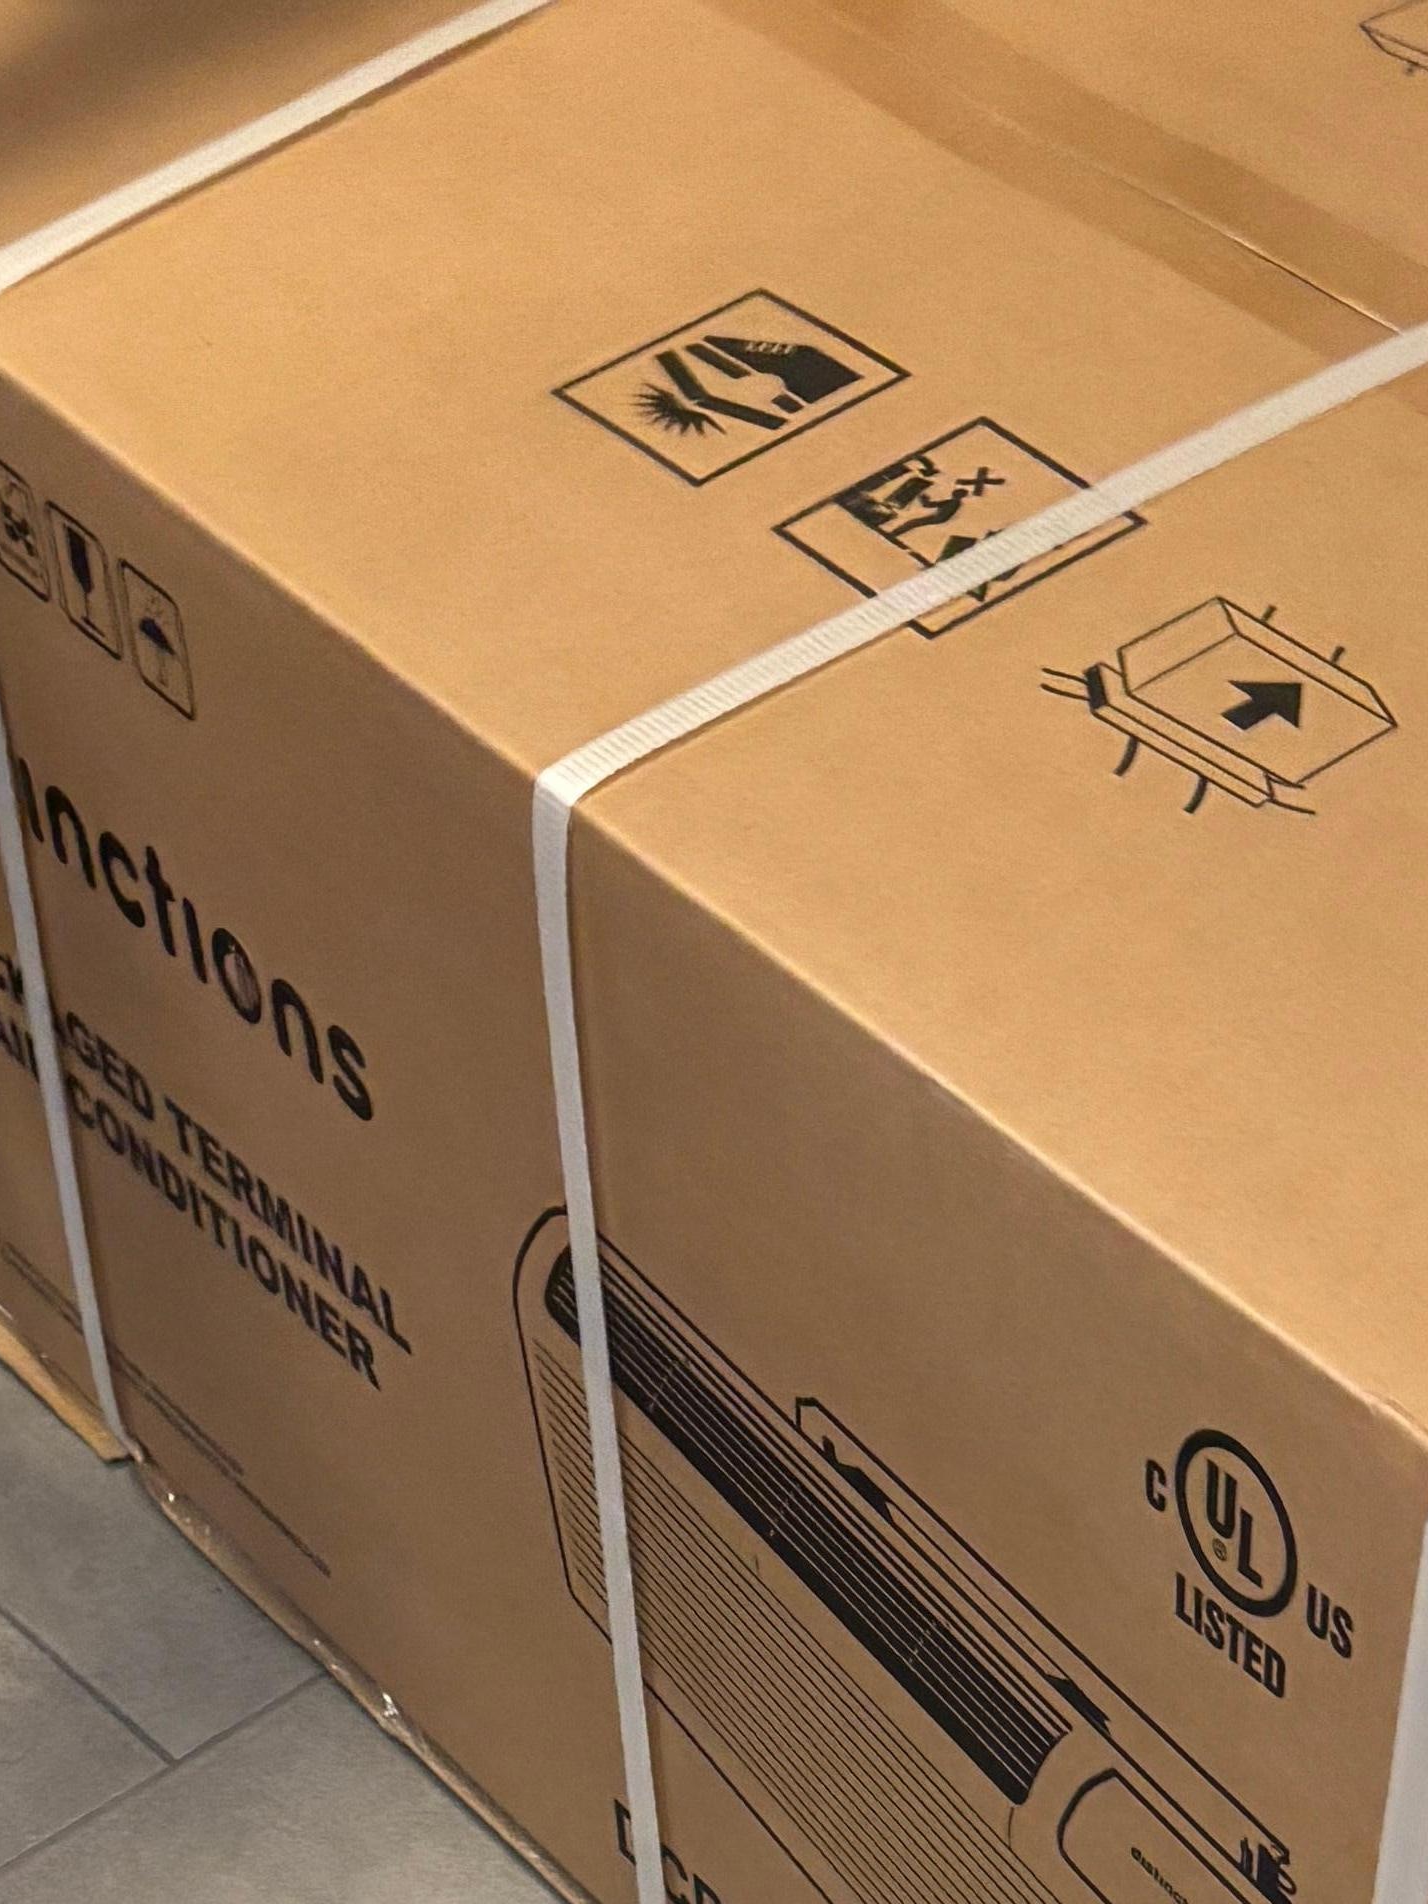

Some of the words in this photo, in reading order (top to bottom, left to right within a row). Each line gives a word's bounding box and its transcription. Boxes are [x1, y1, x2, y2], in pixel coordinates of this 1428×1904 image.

[65, 1072, 382, 1391] CONDITIONER
[165, 1095, 412, 1355] TERMINAL
[1204, 1458, 1264, 1589] UL
[1174, 1570, 1286, 1699] LISTED
[1306, 1582, 1354, 1659] US
